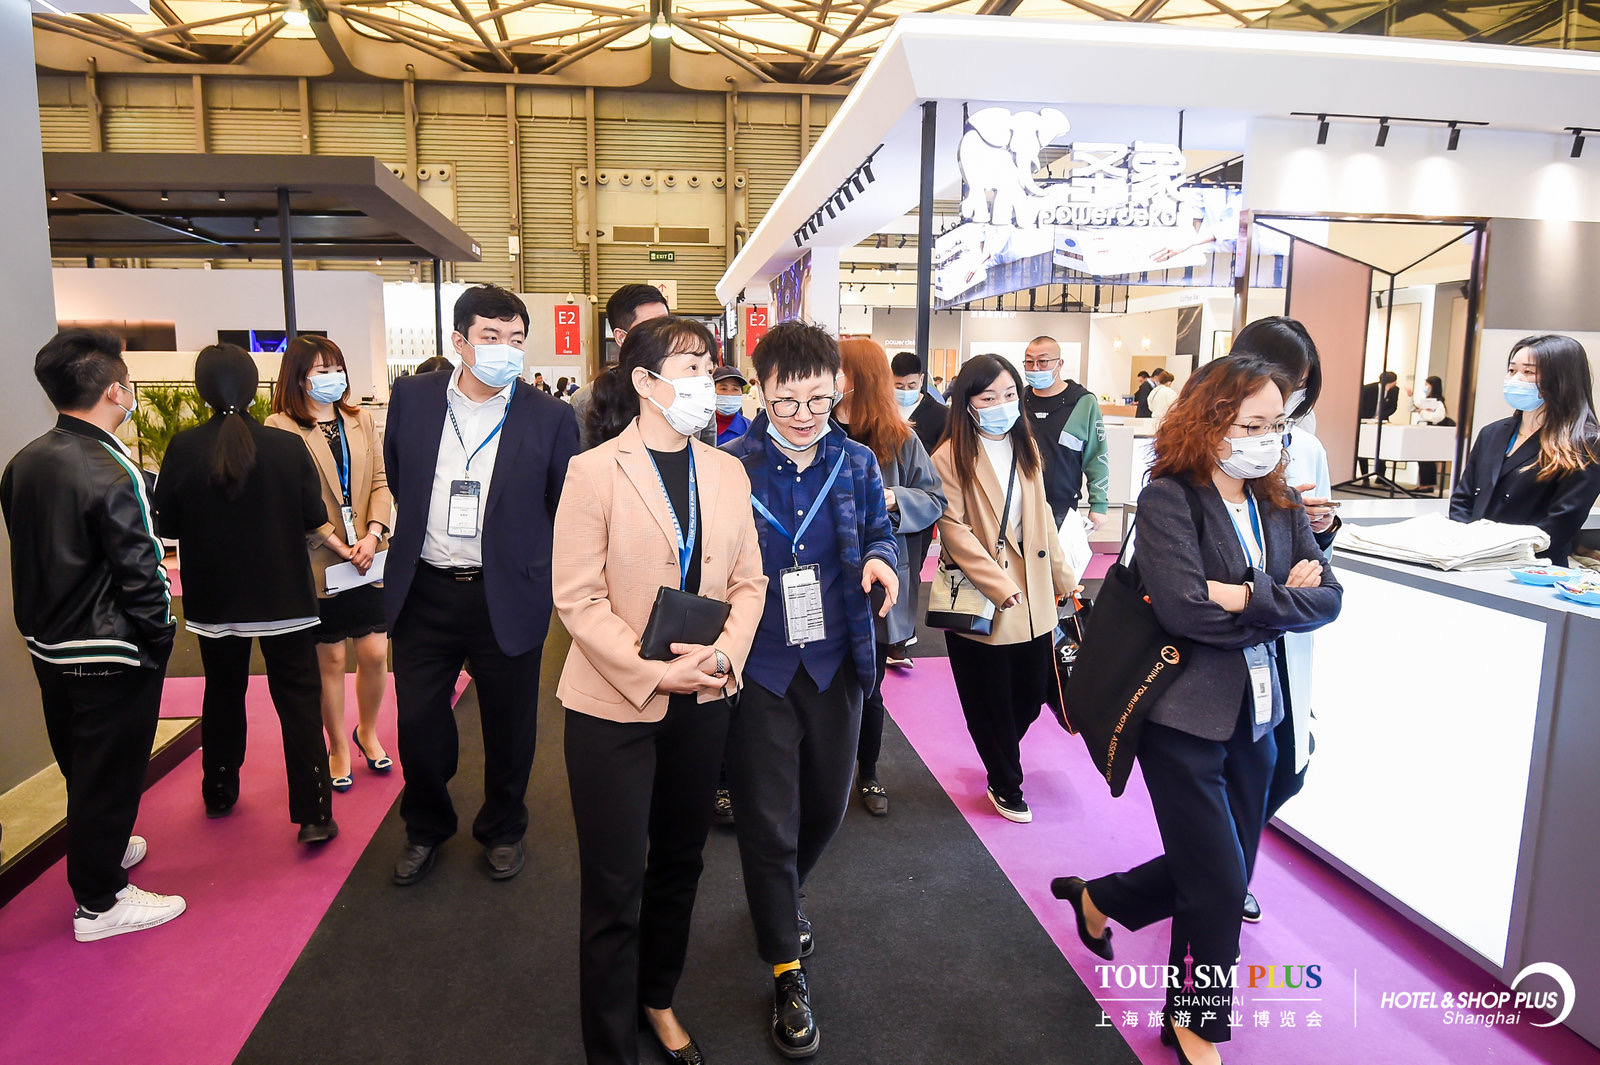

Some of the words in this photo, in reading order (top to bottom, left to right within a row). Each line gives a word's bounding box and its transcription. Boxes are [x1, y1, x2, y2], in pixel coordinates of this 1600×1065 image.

[558, 311, 576, 325] E2
[749, 313, 766, 327] E2
[564, 336, 570, 349] 1
[1144, 662, 1165, 683] CHINA
[1126, 685, 1149, 714] TOURIST
[1114, 711, 1129, 734] HOTEL
